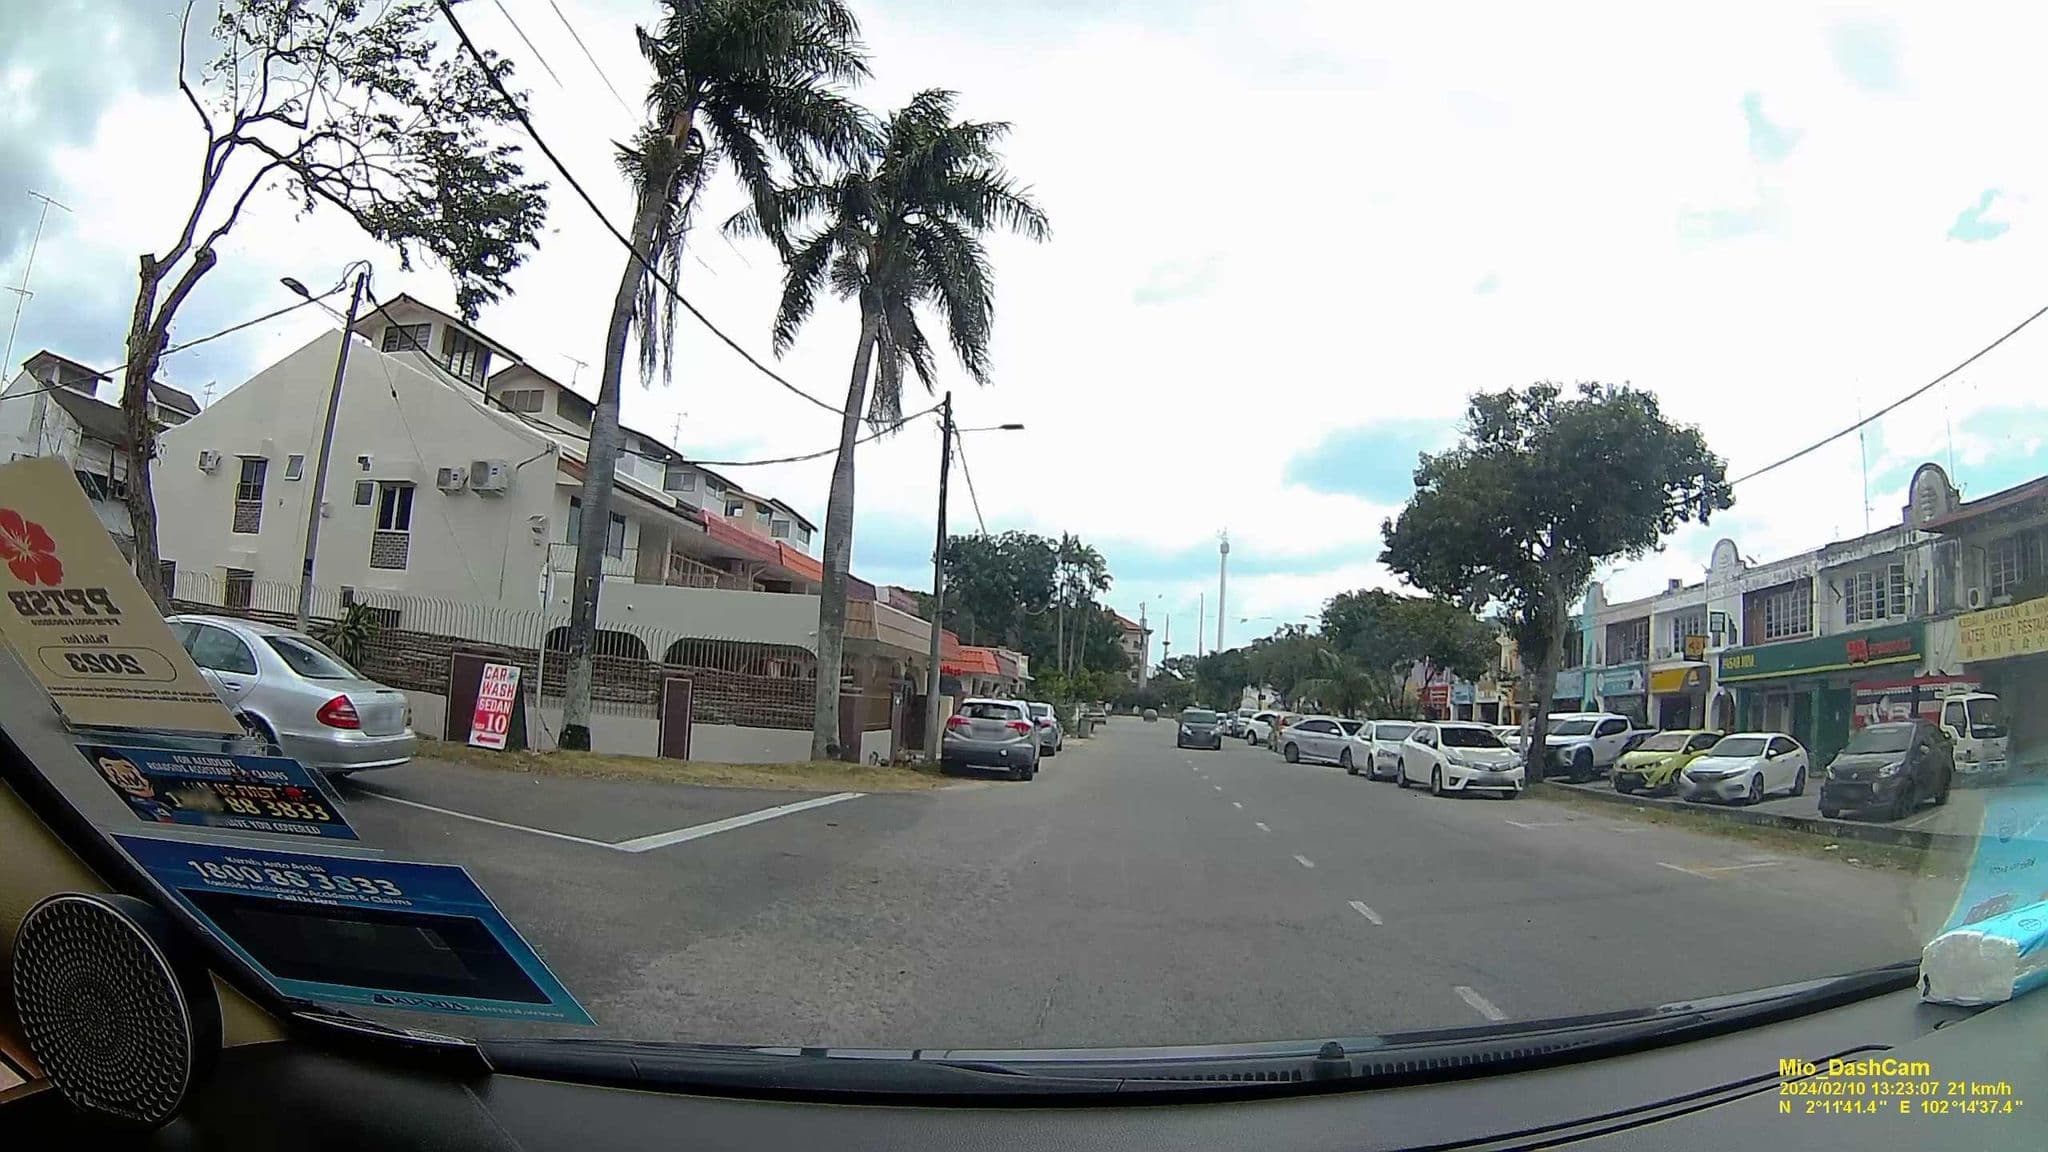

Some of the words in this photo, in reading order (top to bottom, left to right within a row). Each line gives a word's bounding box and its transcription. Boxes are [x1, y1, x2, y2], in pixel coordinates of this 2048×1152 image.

[1991, 622, 2013, 640] GATE
[485, 666, 508, 681] CAR
[482, 681, 515, 698] WASH
[479, 698, 512, 715] SEDAN
[485, 713, 508, 734] 10
[251, 769, 289, 781] CLAIMS
[214, 783, 236, 797] US
[235, 784, 278, 799] FIRST
[225, 797, 261, 815] 88
[261, 799, 331, 821] 3833
[249, 820, 273, 831] YOU
[271, 822, 321, 835] COVERED
[290, 862, 327, 873] Assist
[187, 861, 264, 883] 1800
[264, 868, 310, 888] 88
[309, 873, 402, 897] 3833
[276, 893, 299, 902] Call
[308, 890, 358, 901] Accident
[369, 896, 413, 906] Claims
